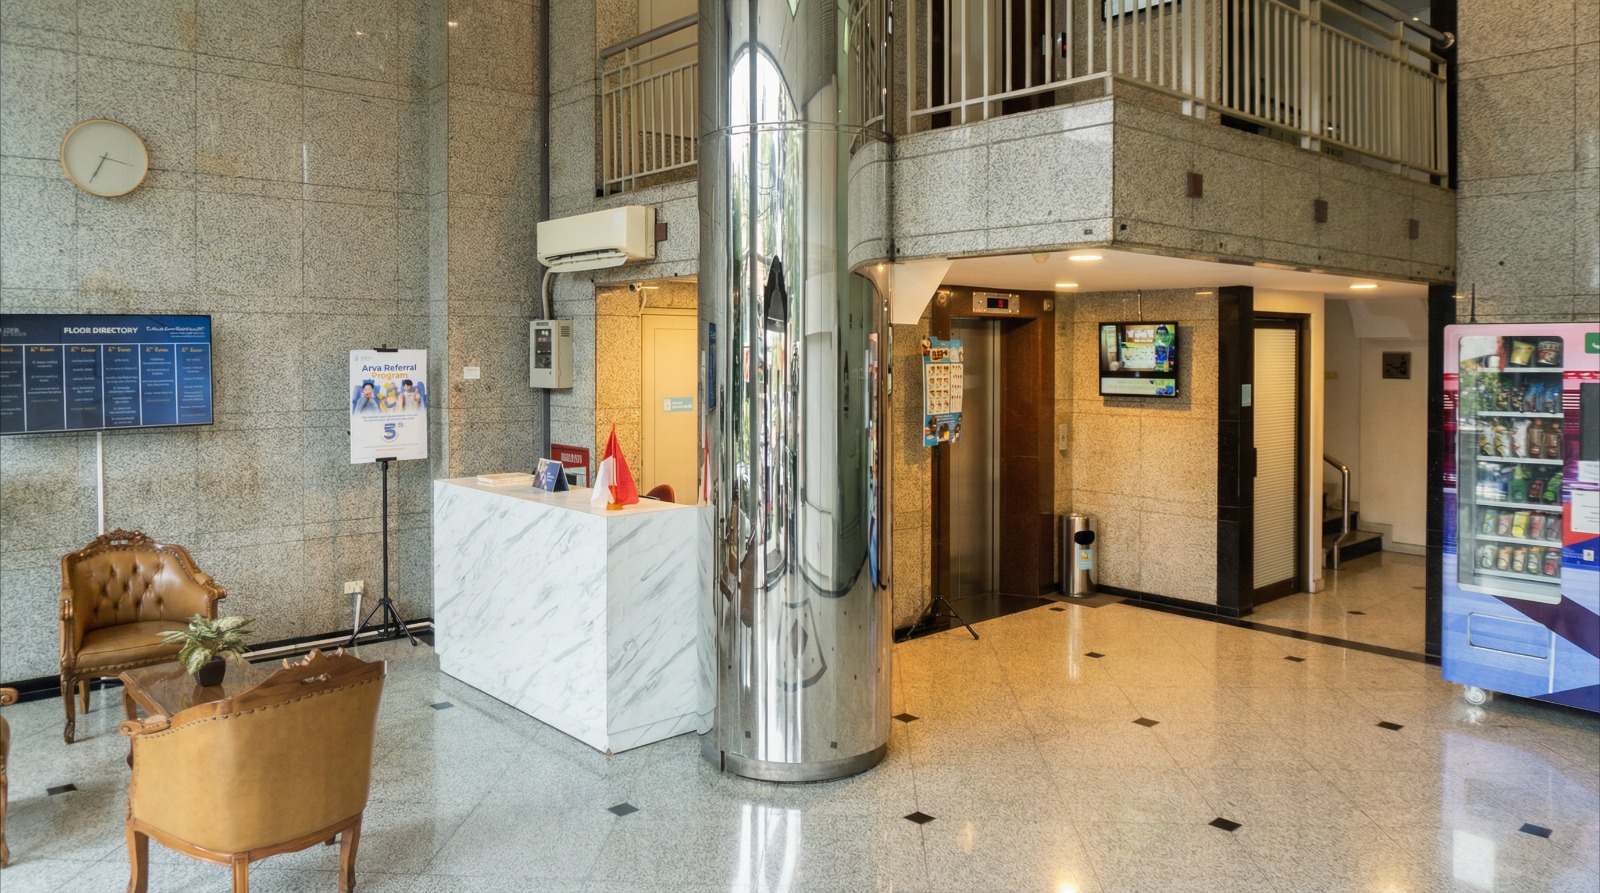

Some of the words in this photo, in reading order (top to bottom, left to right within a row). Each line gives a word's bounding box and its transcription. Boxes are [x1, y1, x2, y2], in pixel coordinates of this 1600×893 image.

[361, 364, 382, 372] Arva
[384, 363, 417, 372] Referral
[371, 371, 408, 380] Program
[383, 423, 397, 440] 5
